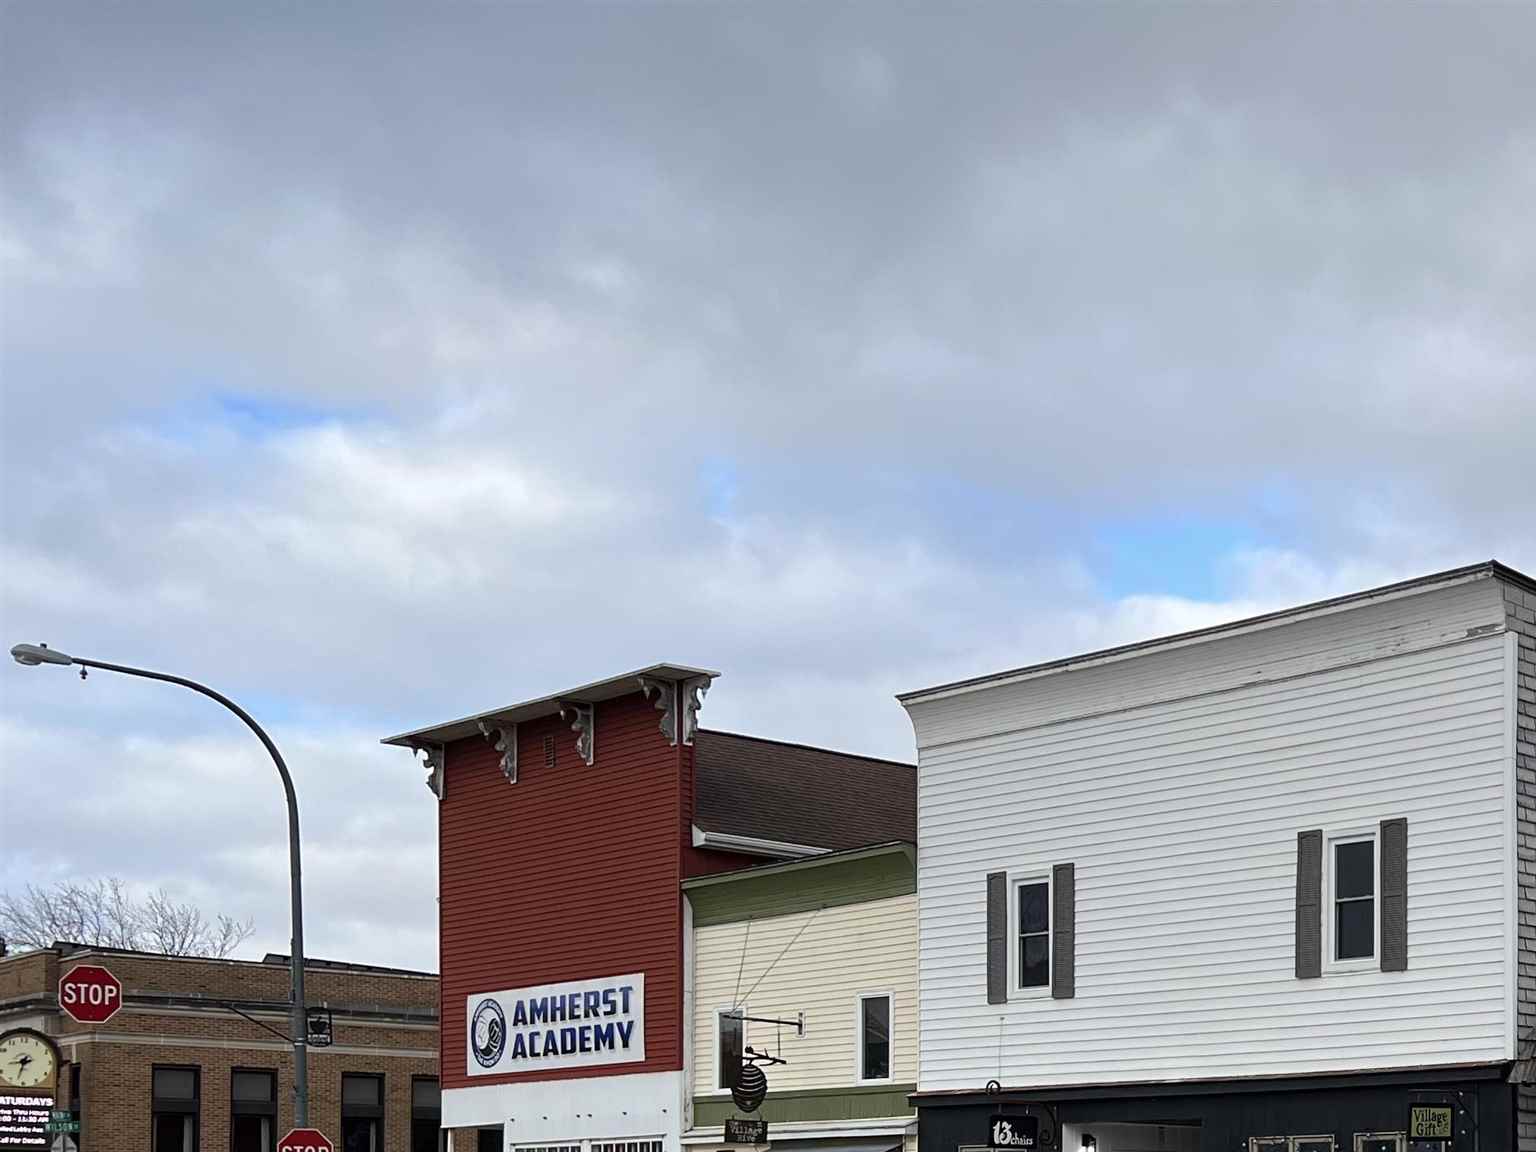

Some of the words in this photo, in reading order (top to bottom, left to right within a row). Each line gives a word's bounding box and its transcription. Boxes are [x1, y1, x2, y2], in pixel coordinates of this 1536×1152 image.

[64, 983, 117, 1005] STOP
[512, 986, 633, 1027] AMHERST
[512, 1020, 635, 1060] ACADEMY
[0, 1096, 54, 1106] ATURDAYS
[1413, 1109, 1448, 1128] Village
[1416, 1122, 1437, 1136] Gift
[992, 1121, 1012, 1145] 13
[1010, 1132, 1033, 1145] chairs
